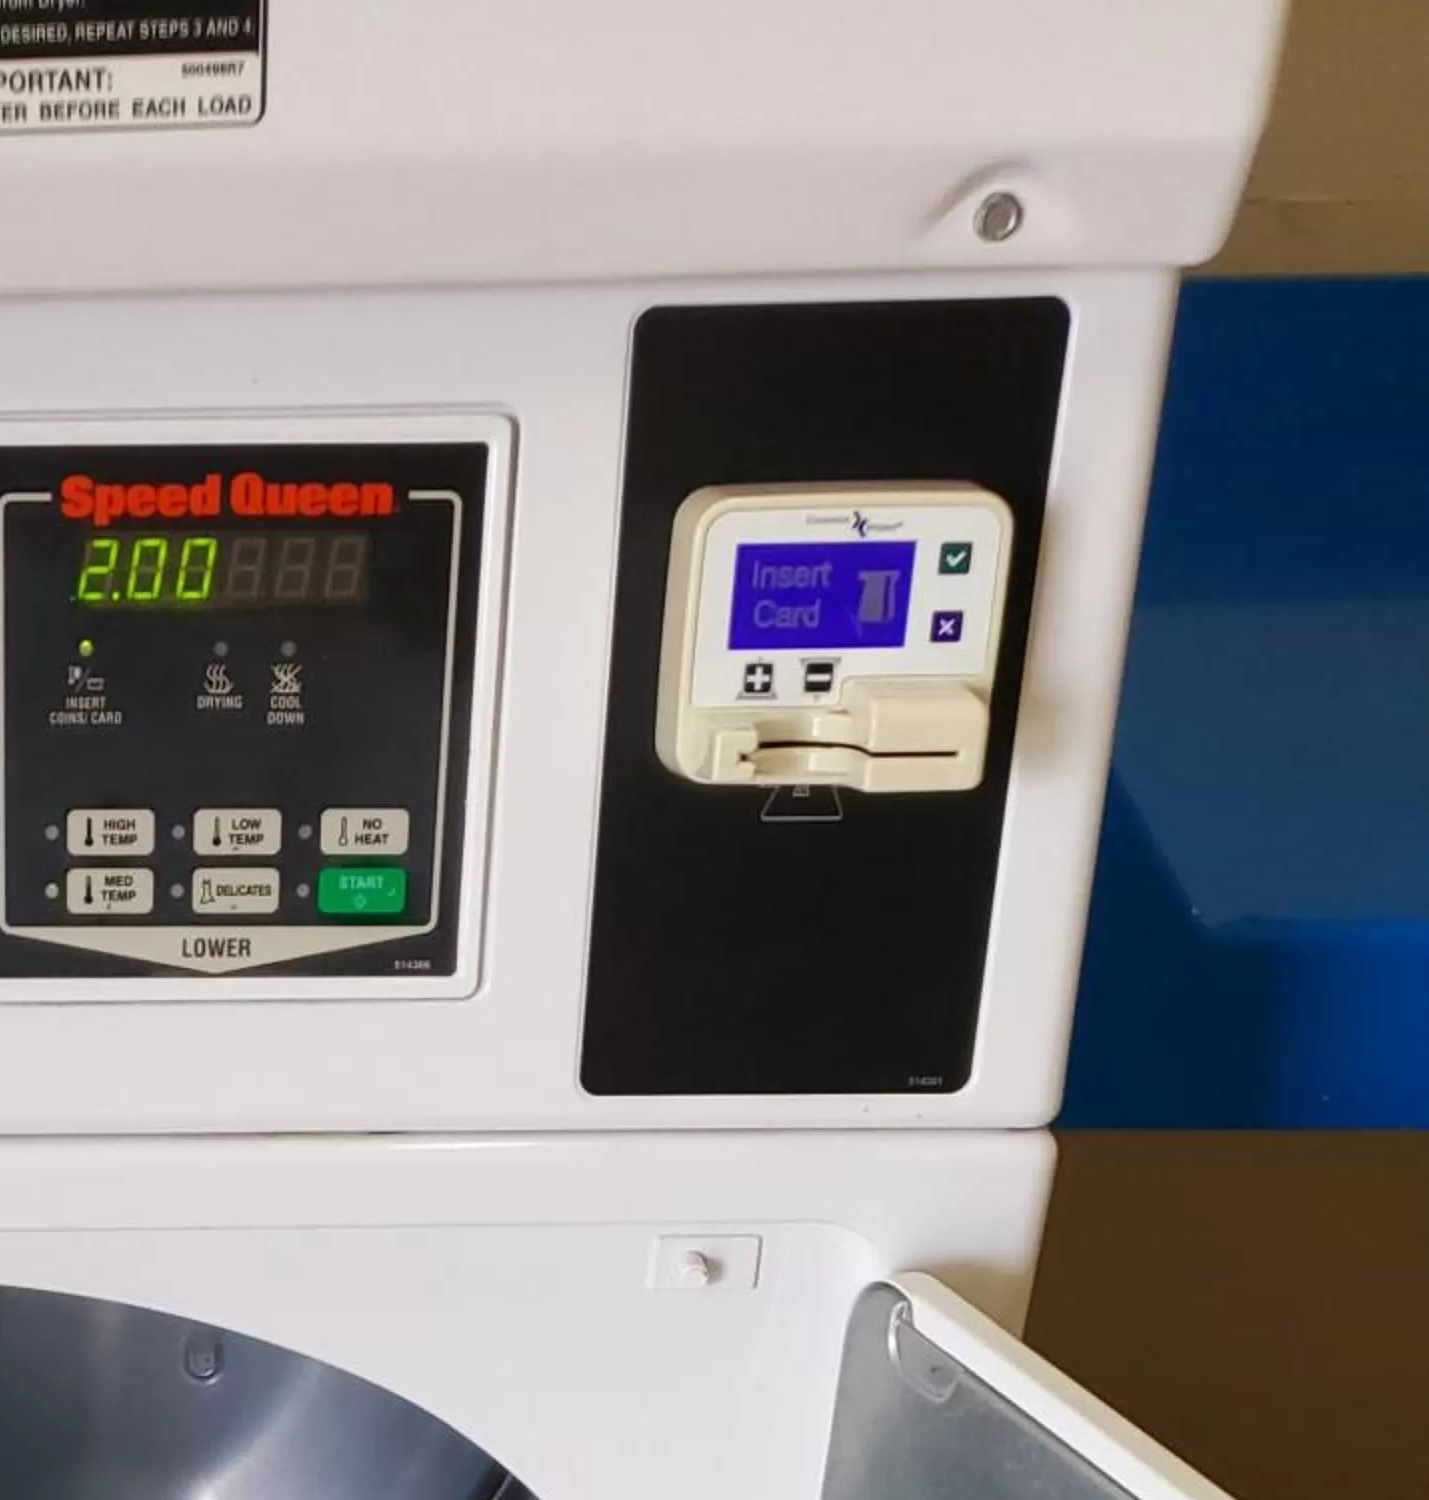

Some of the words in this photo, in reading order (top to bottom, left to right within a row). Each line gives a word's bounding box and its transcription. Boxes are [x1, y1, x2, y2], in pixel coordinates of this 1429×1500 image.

[75, 18, 135, 43] REPEAT
[139, 17, 189, 41] STEPS
[192, 17, 202, 38] 3
[206, 16, 239, 38] AND
[39, 97, 120, 121] BEFORE
[131, 96, 186, 119] EACH
[197, 94, 253, 116] LOAD
[59, 473, 222, 525] Speed
[230, 471, 396, 517] Queen
[77, 536, 218, 602] 2.00
[751, 560, 833, 590] Insert
[753, 598, 822, 629] Card
[65, 695, 107, 710] INSERT
[196, 695, 244, 710] DRYING
[270, 695, 303, 709] COOL
[90, 711, 122, 725] CARD
[266, 711, 306, 725] DOWN
[102, 819, 137, 832] HIGH
[231, 819, 262, 832] LOW
[362, 819, 383, 832] NO
[101, 833, 139, 846] TEMP
[228, 833, 265, 846] TEMP
[354, 833, 390, 846] HEAT
[103, 875, 134, 888] MED
[339, 875, 384, 891] START
[100, 890, 137, 903] TEMP
[215, 884, 272, 898] DELICATES
[181, 937, 252, 960] LOWER
